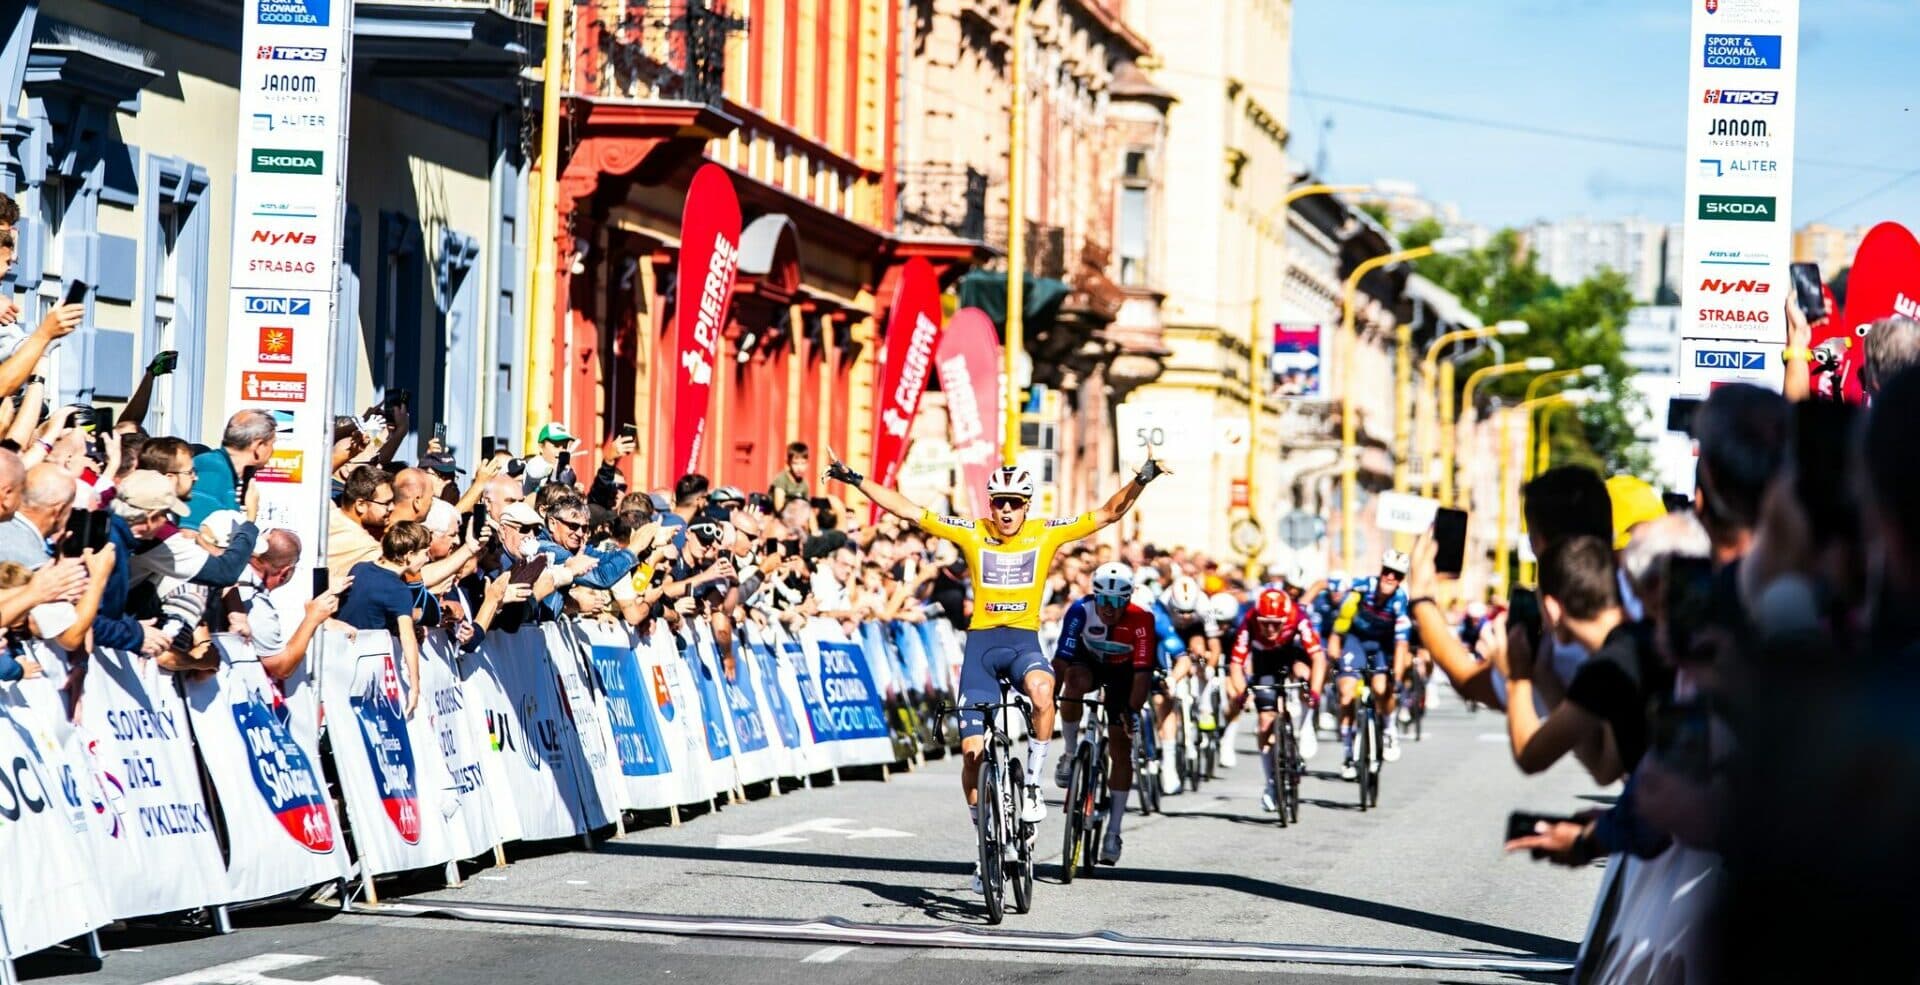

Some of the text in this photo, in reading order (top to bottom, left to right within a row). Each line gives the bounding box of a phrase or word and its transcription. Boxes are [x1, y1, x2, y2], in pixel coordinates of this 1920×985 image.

[260, 13, 317, 24] GOOD IDEA
[1708, 37, 1752, 47] SPORT &
[277, 48, 324, 60] TIPOS
[1707, 47, 1757, 56] SLOVAKIA
[1707, 56, 1767, 66] GOOD IDEA
[1723, 91, 1776, 104] TIPOS
[1730, 160, 1776, 171] ALITER
[251, 230, 317, 246] NyNa
[249, 259, 316, 273] STRABAG
[694, 232, 732, 349] PIERRE
[1700, 278, 1770, 294] NyNa
[1698, 309, 1769, 323] STRABAG
[1137, 427, 1164, 447] 50
